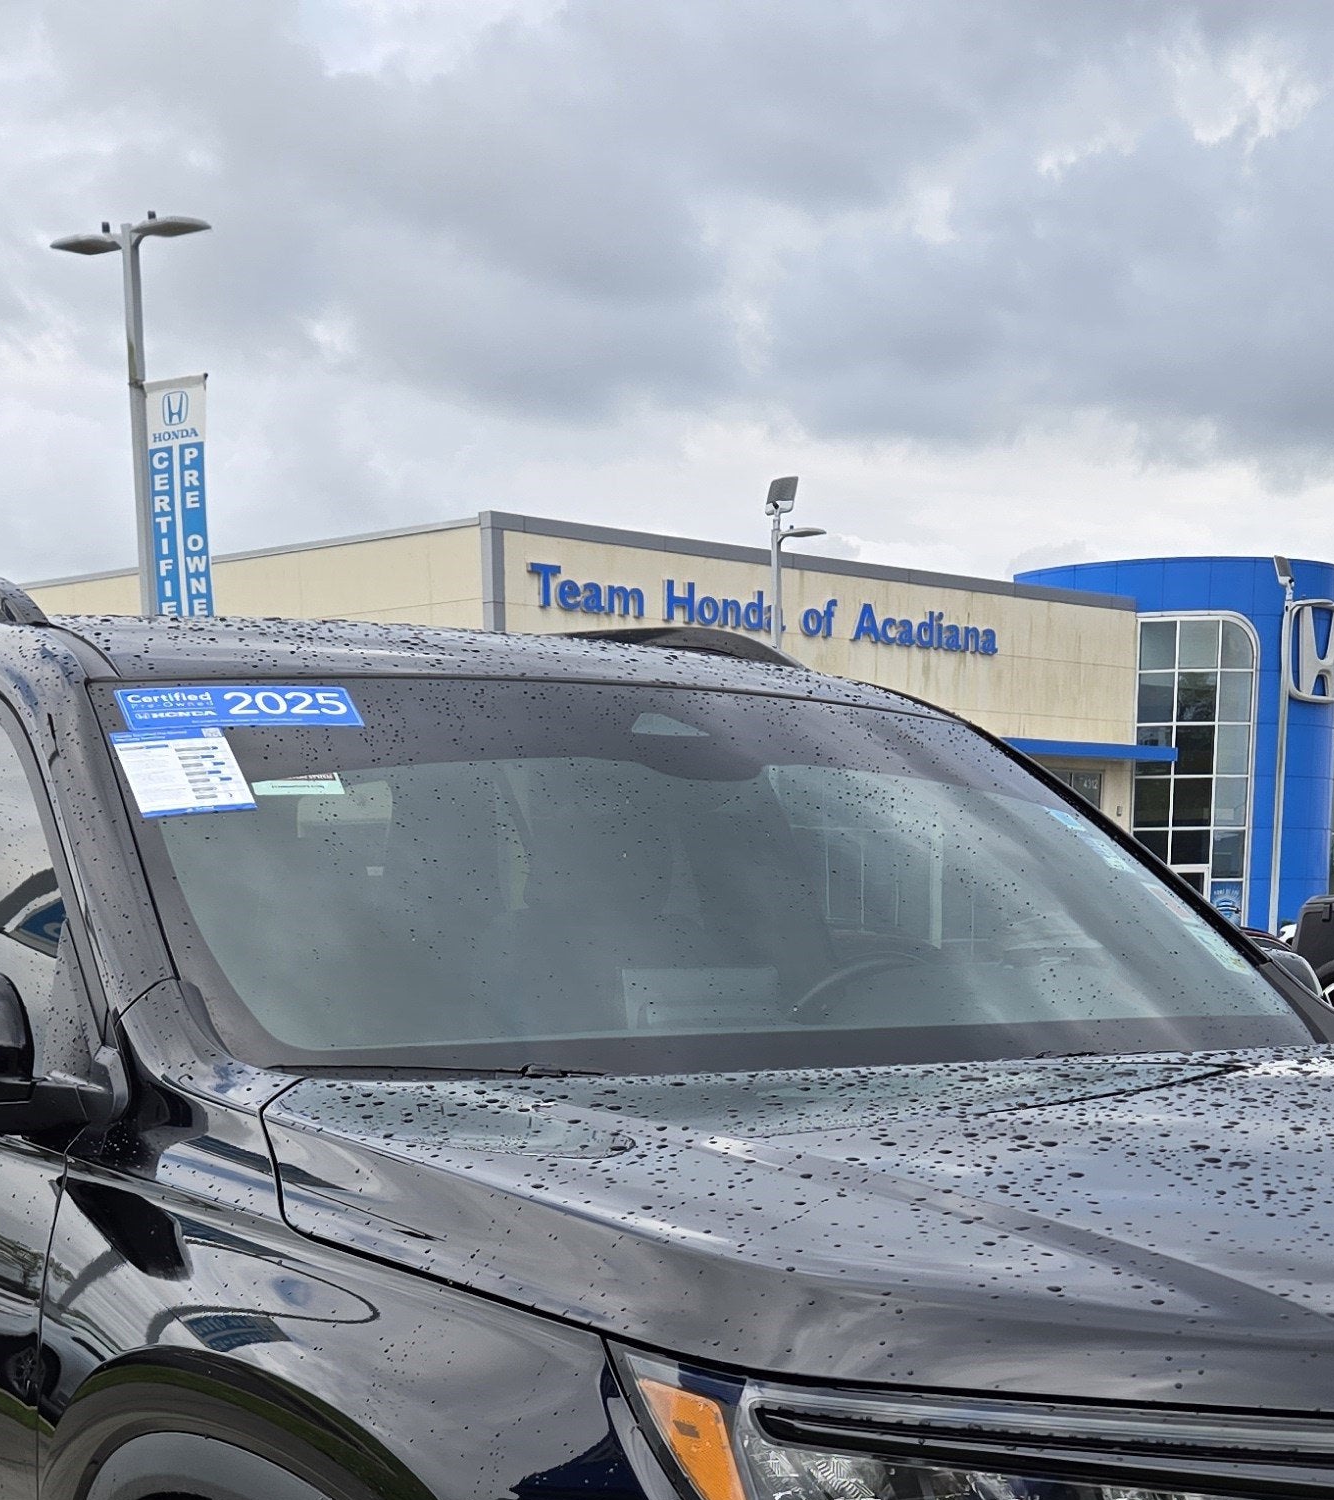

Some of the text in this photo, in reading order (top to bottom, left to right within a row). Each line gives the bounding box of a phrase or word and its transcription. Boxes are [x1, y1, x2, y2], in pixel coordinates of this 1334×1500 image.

[152, 428, 199, 443] HONDA
[183, 448, 200, 509] PRE
[527, 562, 645, 618] Team
[800, 599, 838, 637] of
[853, 603, 998, 656] Acadiana
[127, 691, 212, 704] Certified
[130, 701, 214, 709] Pre-Owned
[223, 691, 348, 715] 2025
